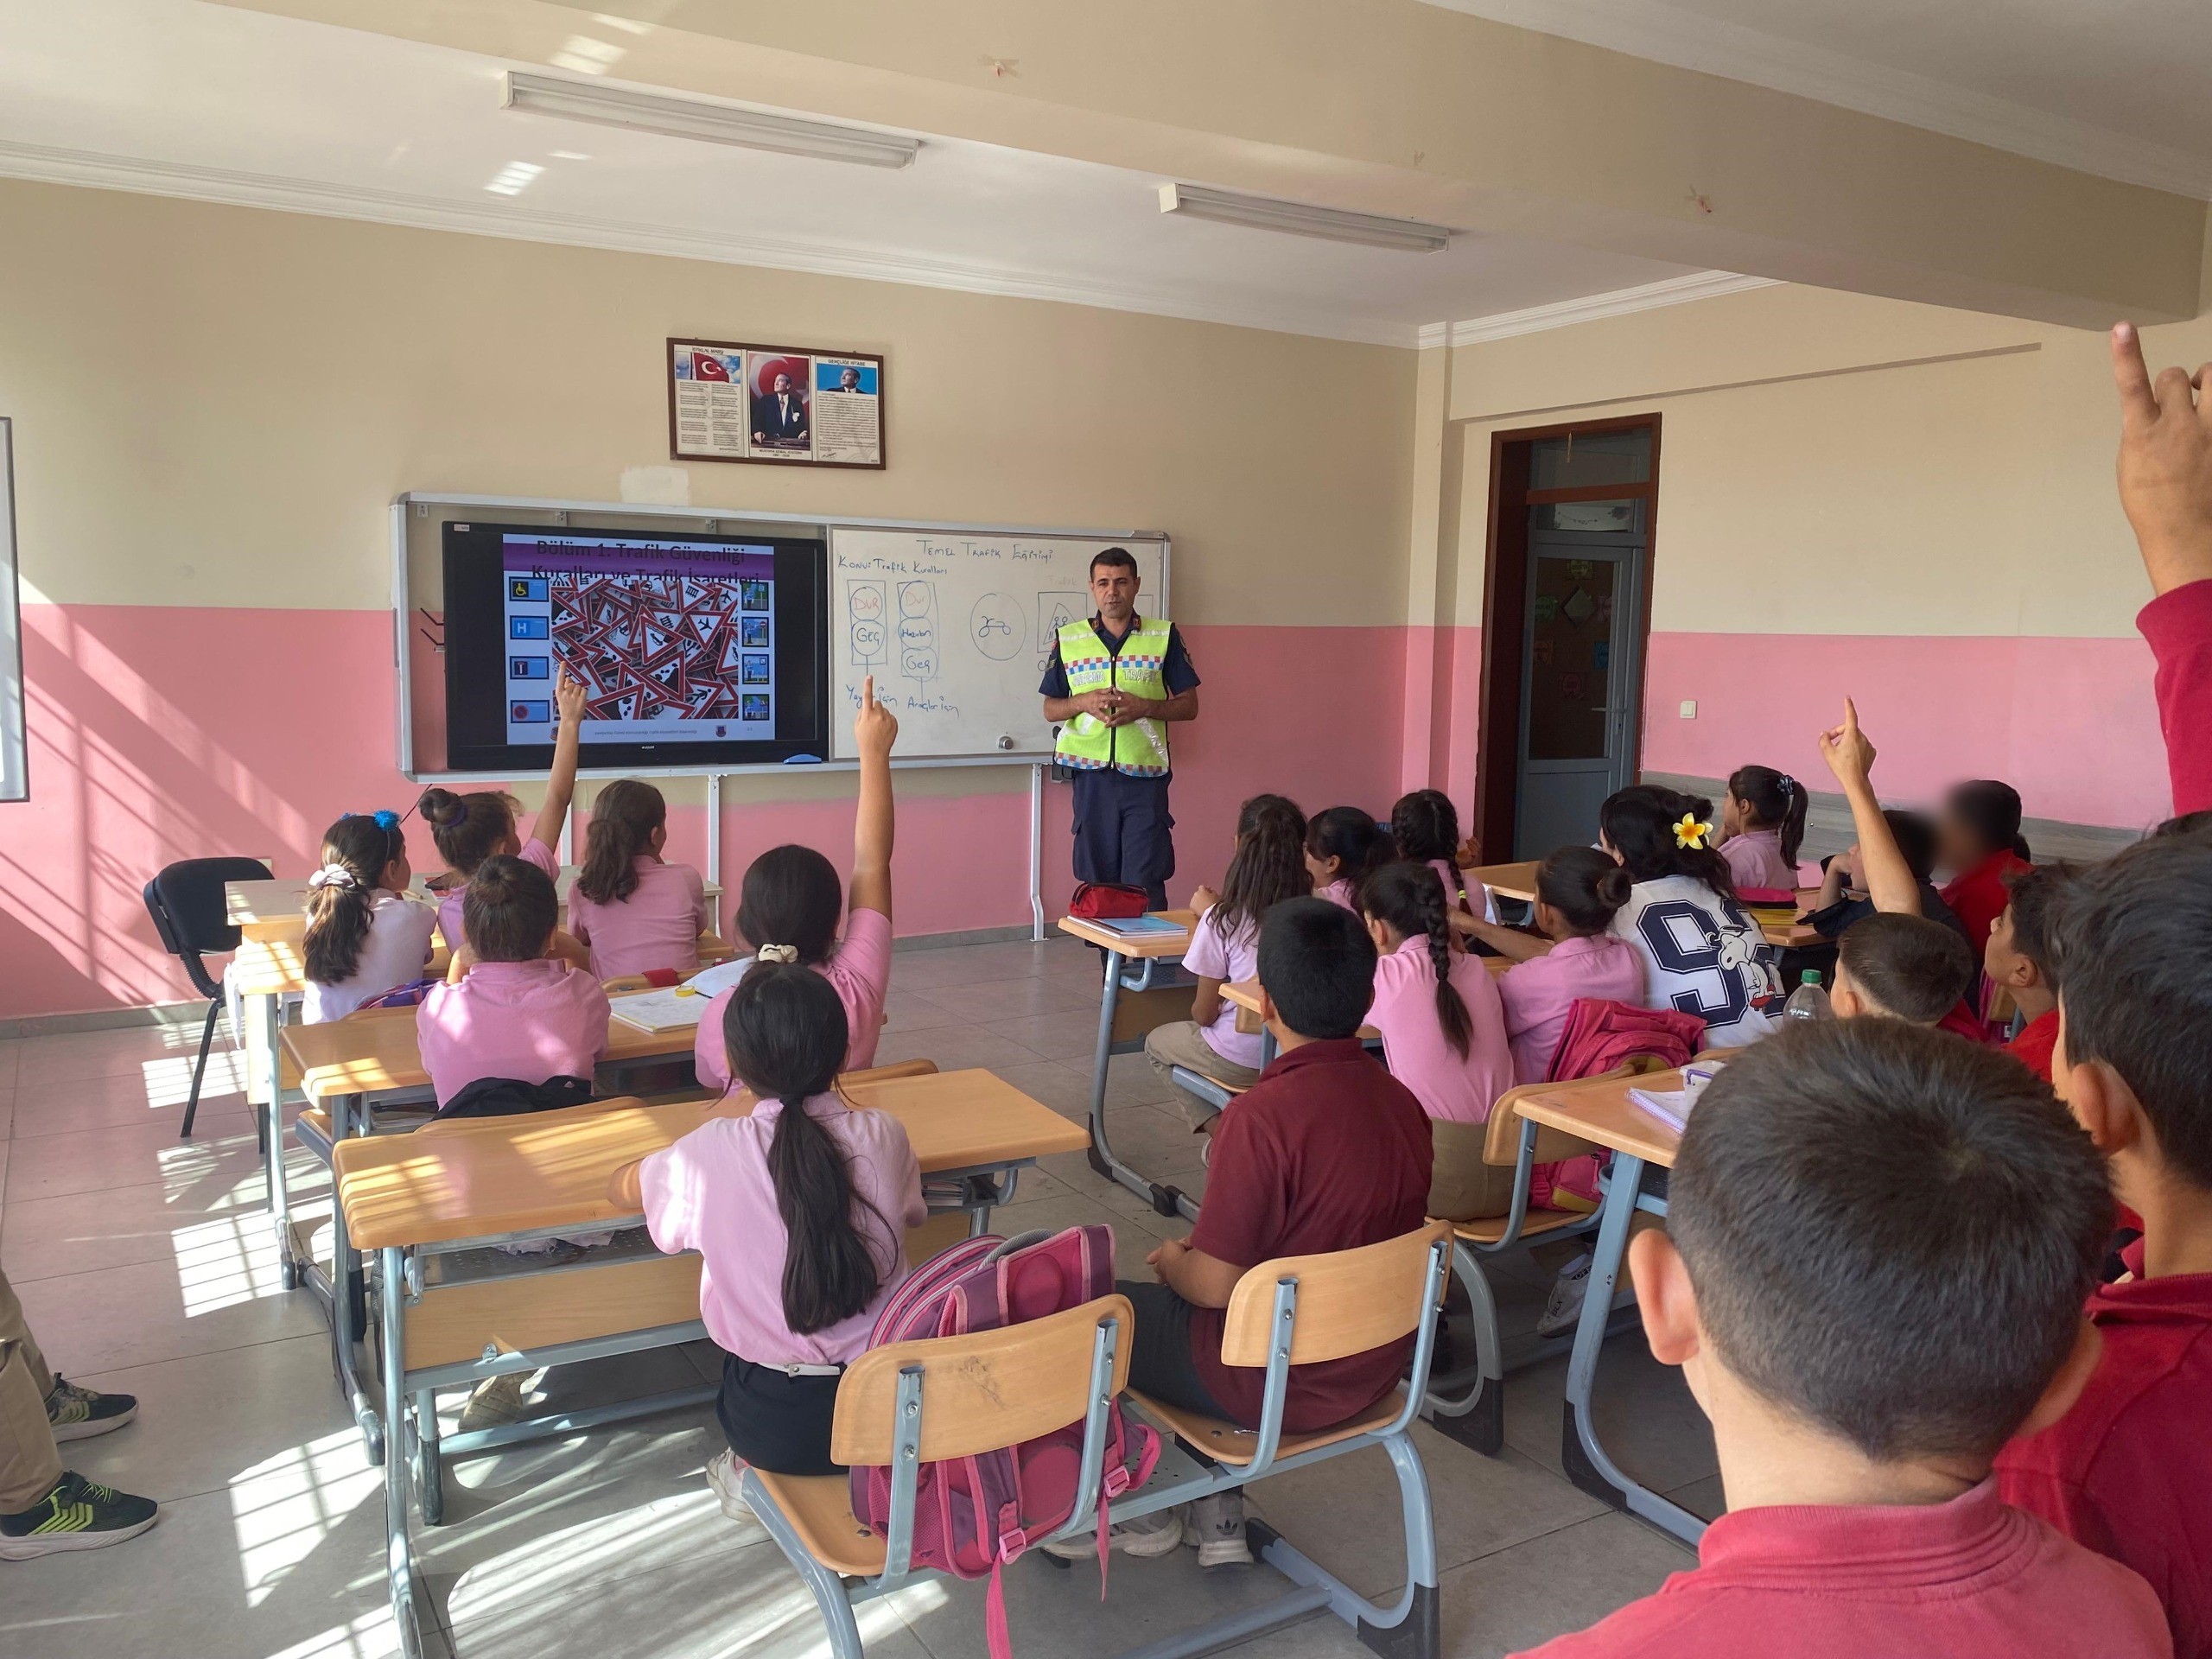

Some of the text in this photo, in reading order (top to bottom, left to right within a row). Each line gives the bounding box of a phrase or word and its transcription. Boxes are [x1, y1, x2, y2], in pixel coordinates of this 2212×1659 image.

[537, 540, 590, 556] Bölüm
[616, 543, 663, 559] Trafik
[670, 546, 745, 565] Güvenliği
[873, 558, 907, 574] Trafik
[636, 569, 682, 582] Trafik
[854, 596, 880, 611] DUR
